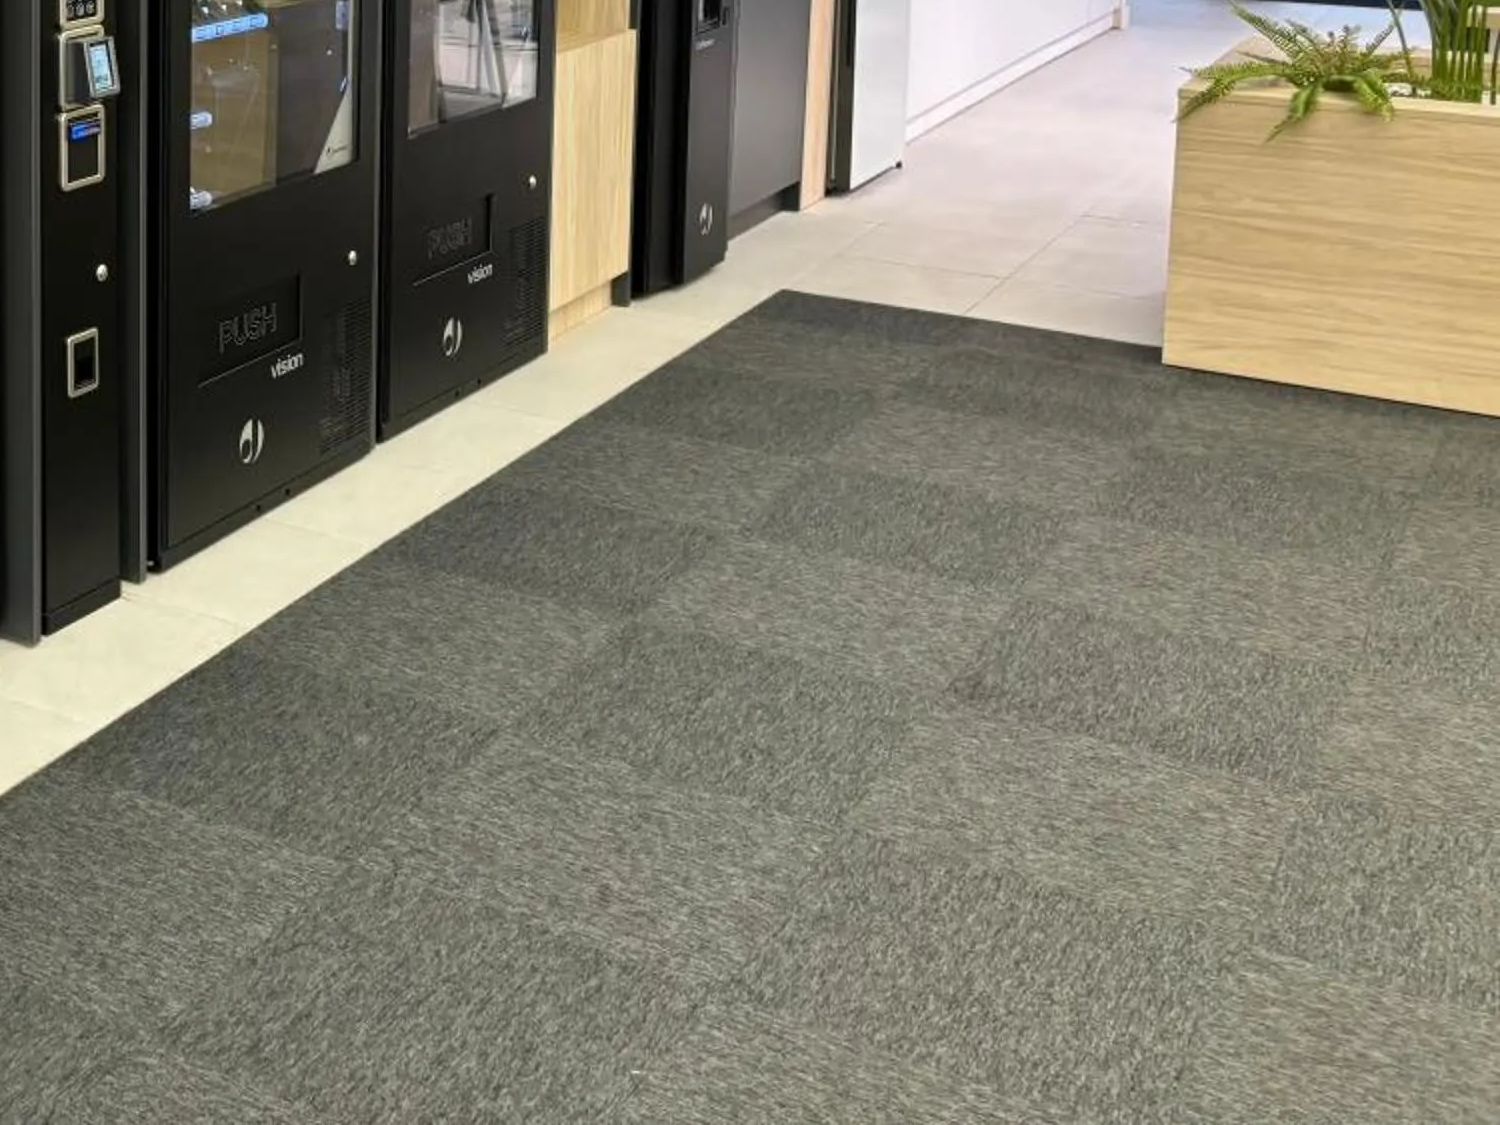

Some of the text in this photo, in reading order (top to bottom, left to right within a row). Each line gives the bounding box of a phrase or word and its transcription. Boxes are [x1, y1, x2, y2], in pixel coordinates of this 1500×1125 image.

[466, 263, 493, 284] vision
[218, 302, 278, 353] PUSH
[270, 352, 304, 379] vision
